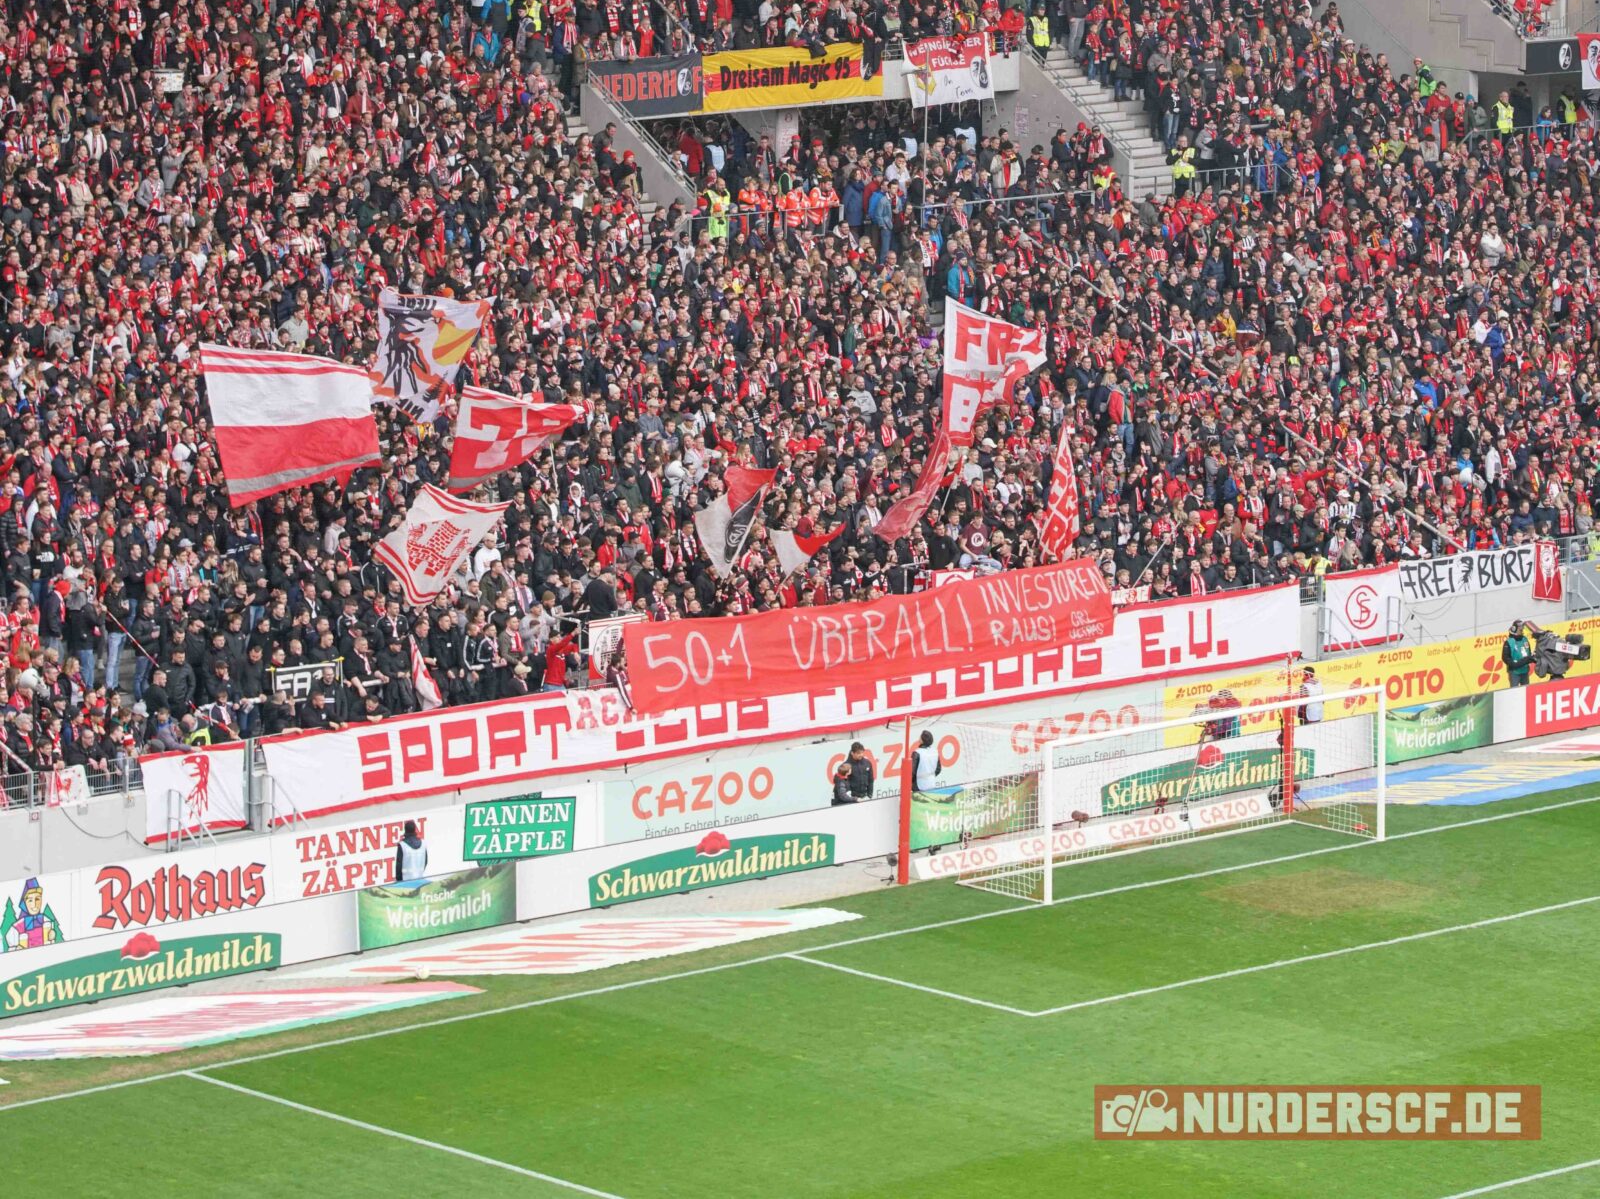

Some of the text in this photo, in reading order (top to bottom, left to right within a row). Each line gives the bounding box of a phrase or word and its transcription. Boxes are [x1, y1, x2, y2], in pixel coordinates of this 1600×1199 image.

[720, 57, 850, 91] Dreisam Magic 95
[978, 566, 1108, 614] INVESTOREN
[1400, 549, 1533, 599] FREI BURG
[643, 623, 752, 693] 50+1
[789, 593, 974, 670] ÜBERALL!
[989, 615, 1057, 646] RAUS!
[1388, 650, 1413, 662] LOTTO
[1186, 684, 1213, 697] LOTTO
[358, 705, 572, 790] SPORT
[1393, 715, 1475, 749] Weidemilch
[827, 735, 961, 785] CZO
[631, 766, 774, 820] CAZOO
[1107, 750, 1309, 809] Schwarzwaldmilh
[470, 802, 571, 827] TANNEN
[925, 796, 1017, 833] Weidemilch
[1108, 815, 1176, 842] CAZOO
[1199, 797, 1262, 825] CAZOO
[472, 828, 565, 854] ZÄPFLE
[302, 857, 398, 898] ZÄPFL
[595, 834, 828, 903] Schwarzwaldmilch
[929, 847, 998, 875] CAZOO
[92, 862, 266, 930] Rothaus
[386, 889, 492, 929] Weidemilch
[421, 889, 456, 904] frische
[4, 934, 273, 1011] Schwarzwaldmilch
